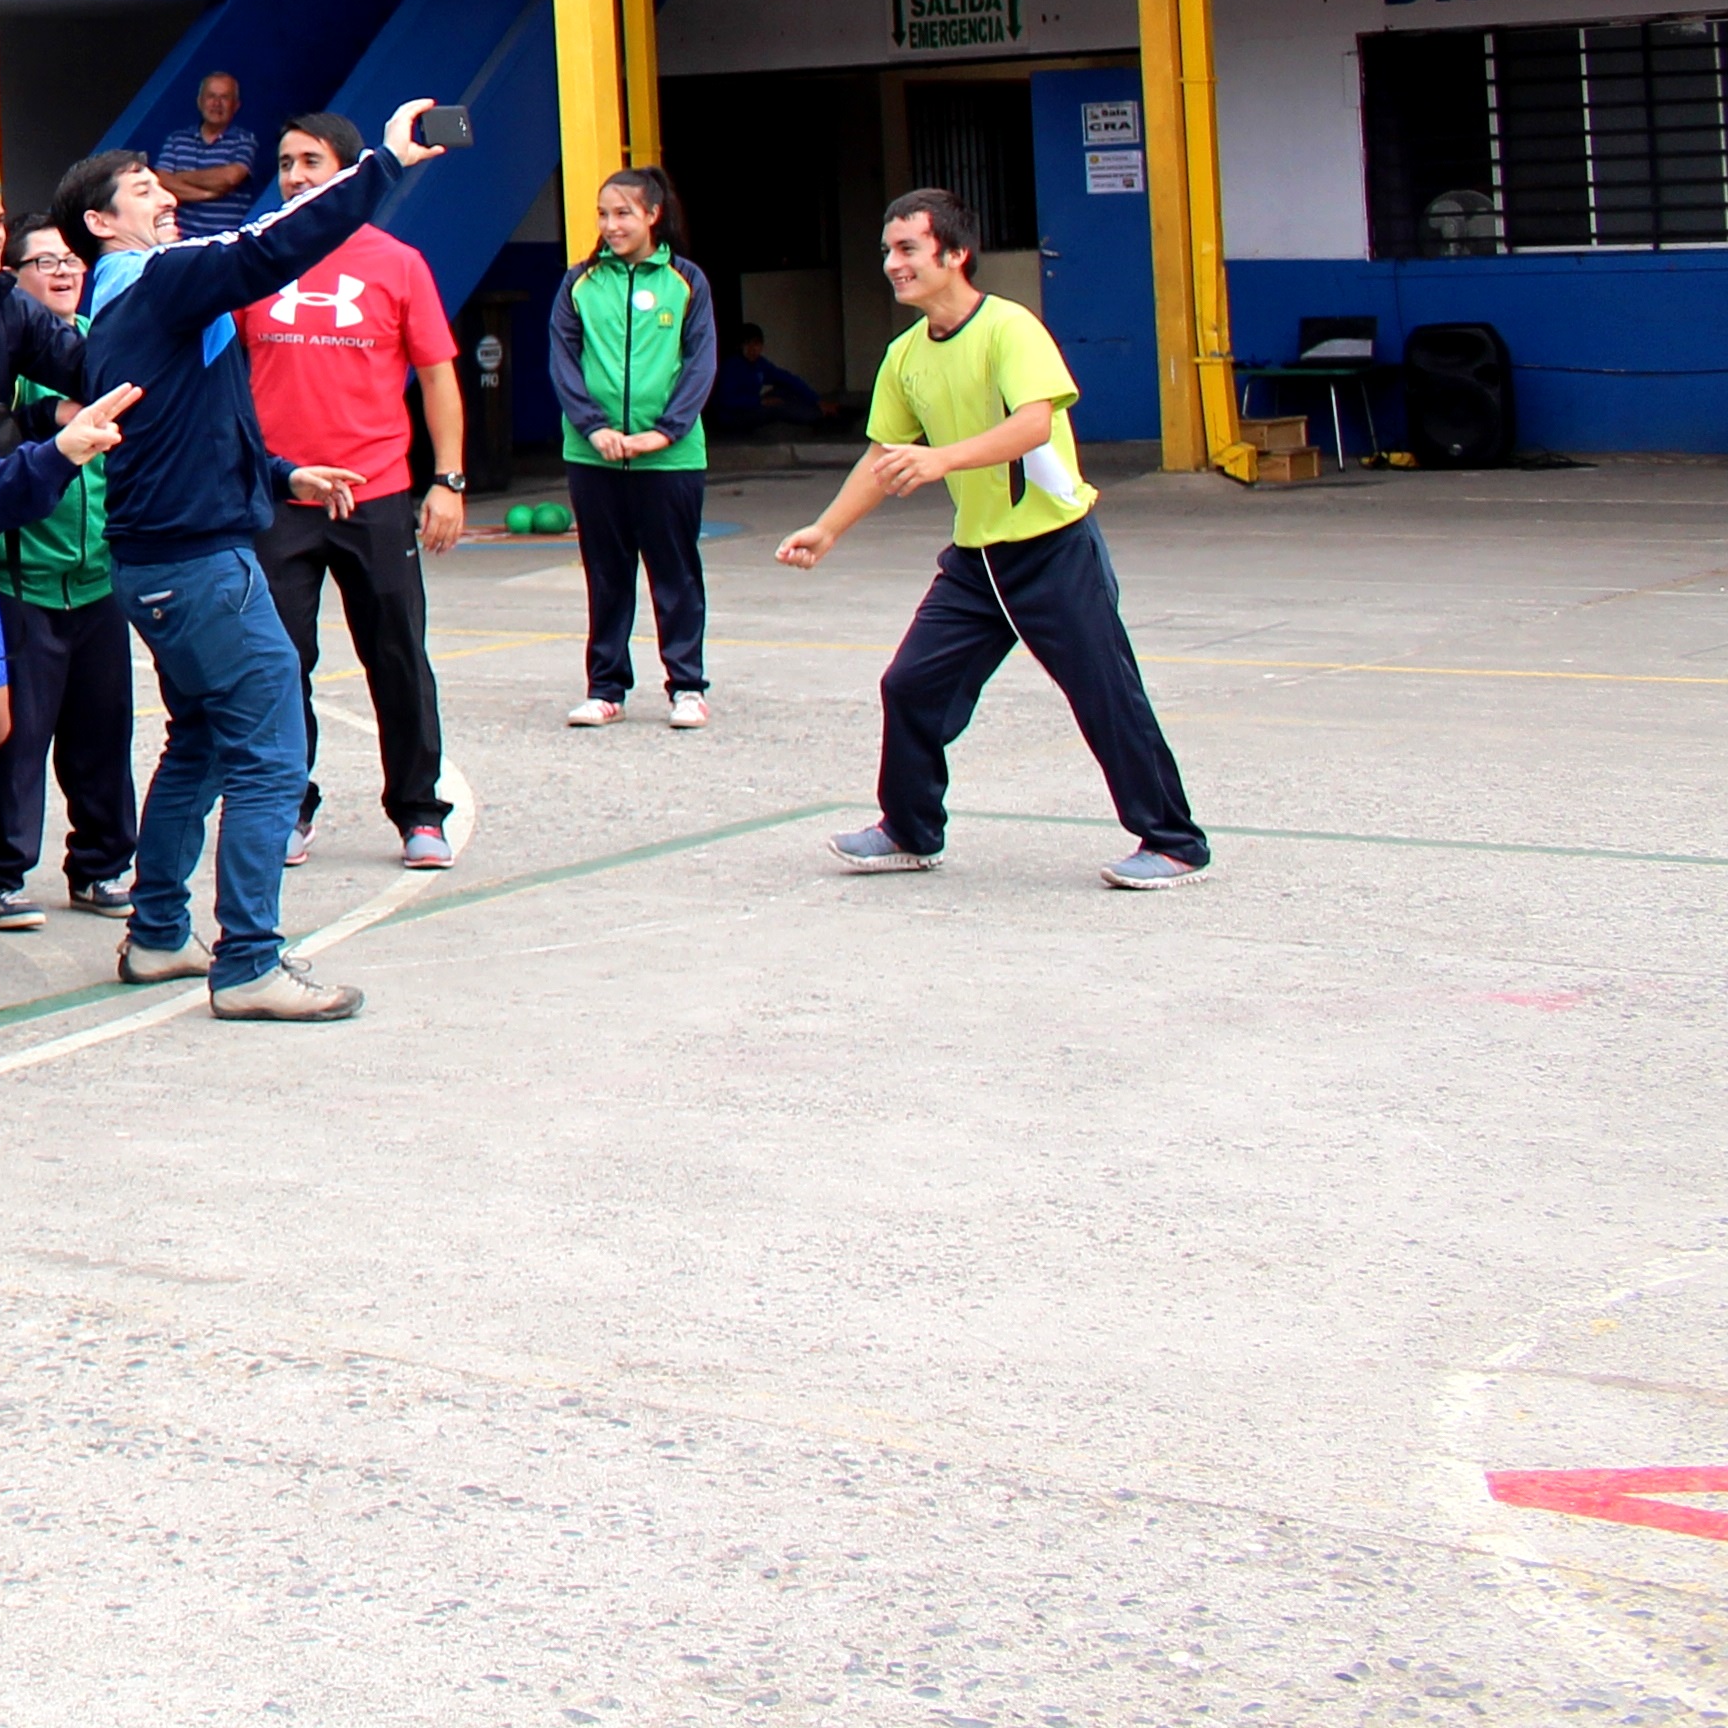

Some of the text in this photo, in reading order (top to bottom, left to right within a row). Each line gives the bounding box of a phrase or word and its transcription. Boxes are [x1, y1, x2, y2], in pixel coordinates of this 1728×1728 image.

[908, 15, 1005, 50] EMERGENCIA
[257, 332, 376, 349] UNDER ARMOUR
